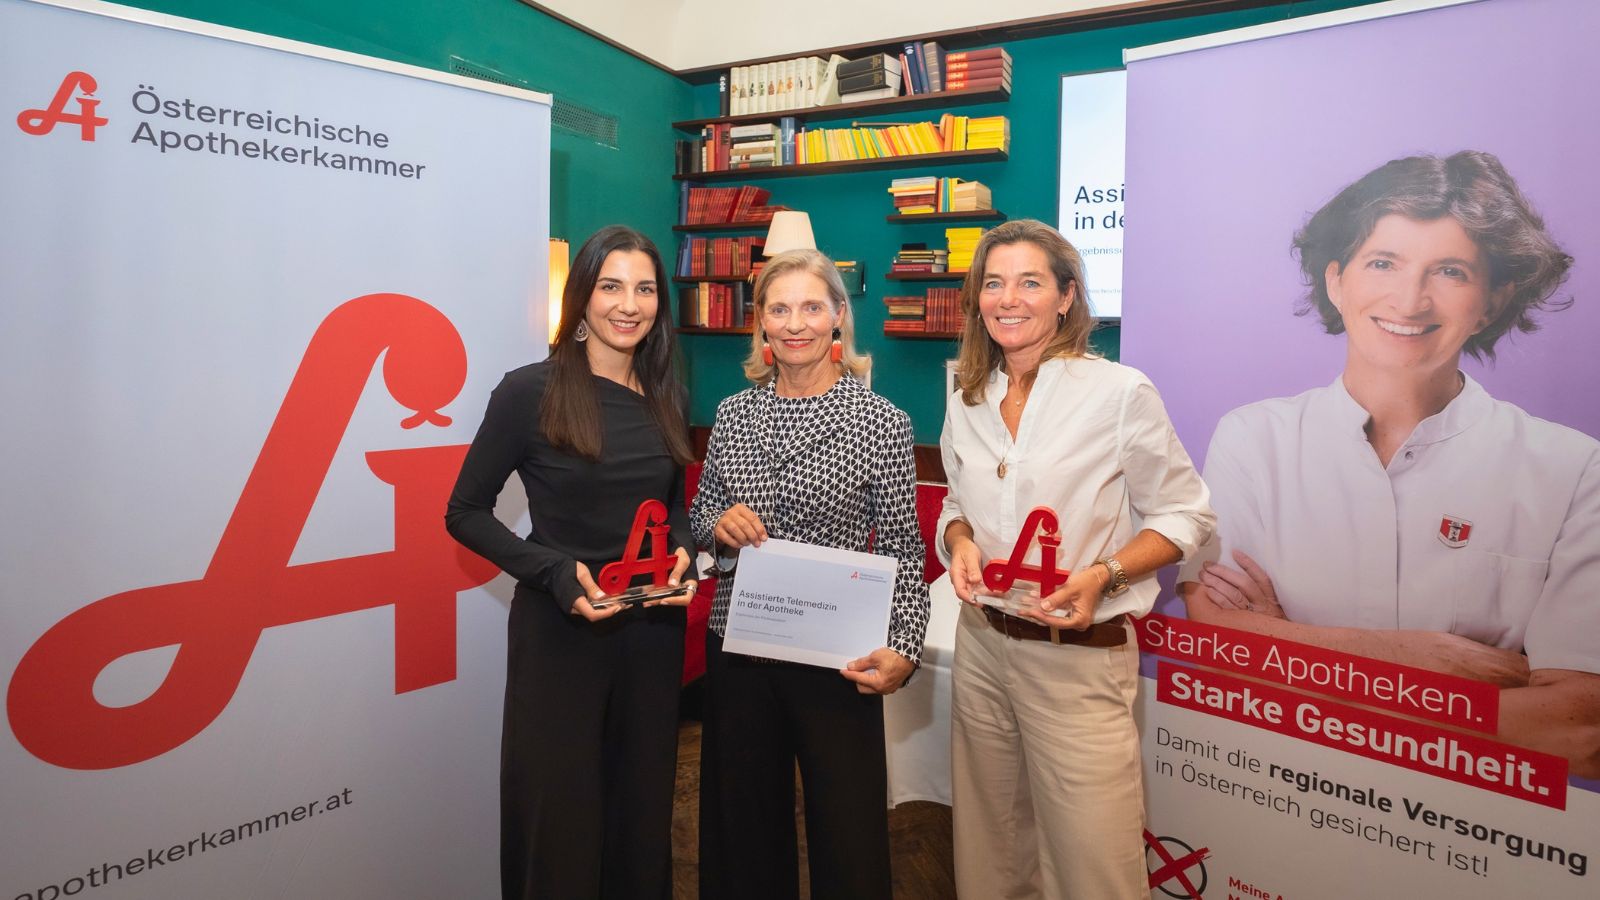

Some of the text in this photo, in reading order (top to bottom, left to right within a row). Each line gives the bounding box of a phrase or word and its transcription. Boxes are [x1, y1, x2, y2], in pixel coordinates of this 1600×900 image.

[132, 84, 389, 148] Österreichische
[131, 121, 426, 180] Apothekerkammer
[1074, 184, 1124, 204] Assi
[1075, 212, 1094, 230] in
[1079, 246, 1122, 257] rgebniss
[737, 599, 804, 616] in der Apotheke
[738, 590, 837, 611] Assistierte Telemedizin
[1145, 619, 1483, 722] Starke Apotheken.
[1171, 672, 1549, 796] Starke Gesundheit.
[1155, 757, 1488, 877] in Österreich gesichert ist!
[1157, 727, 1588, 876] Damit die regionale Versorgung
[1229, 876, 1270, 900] Meine
